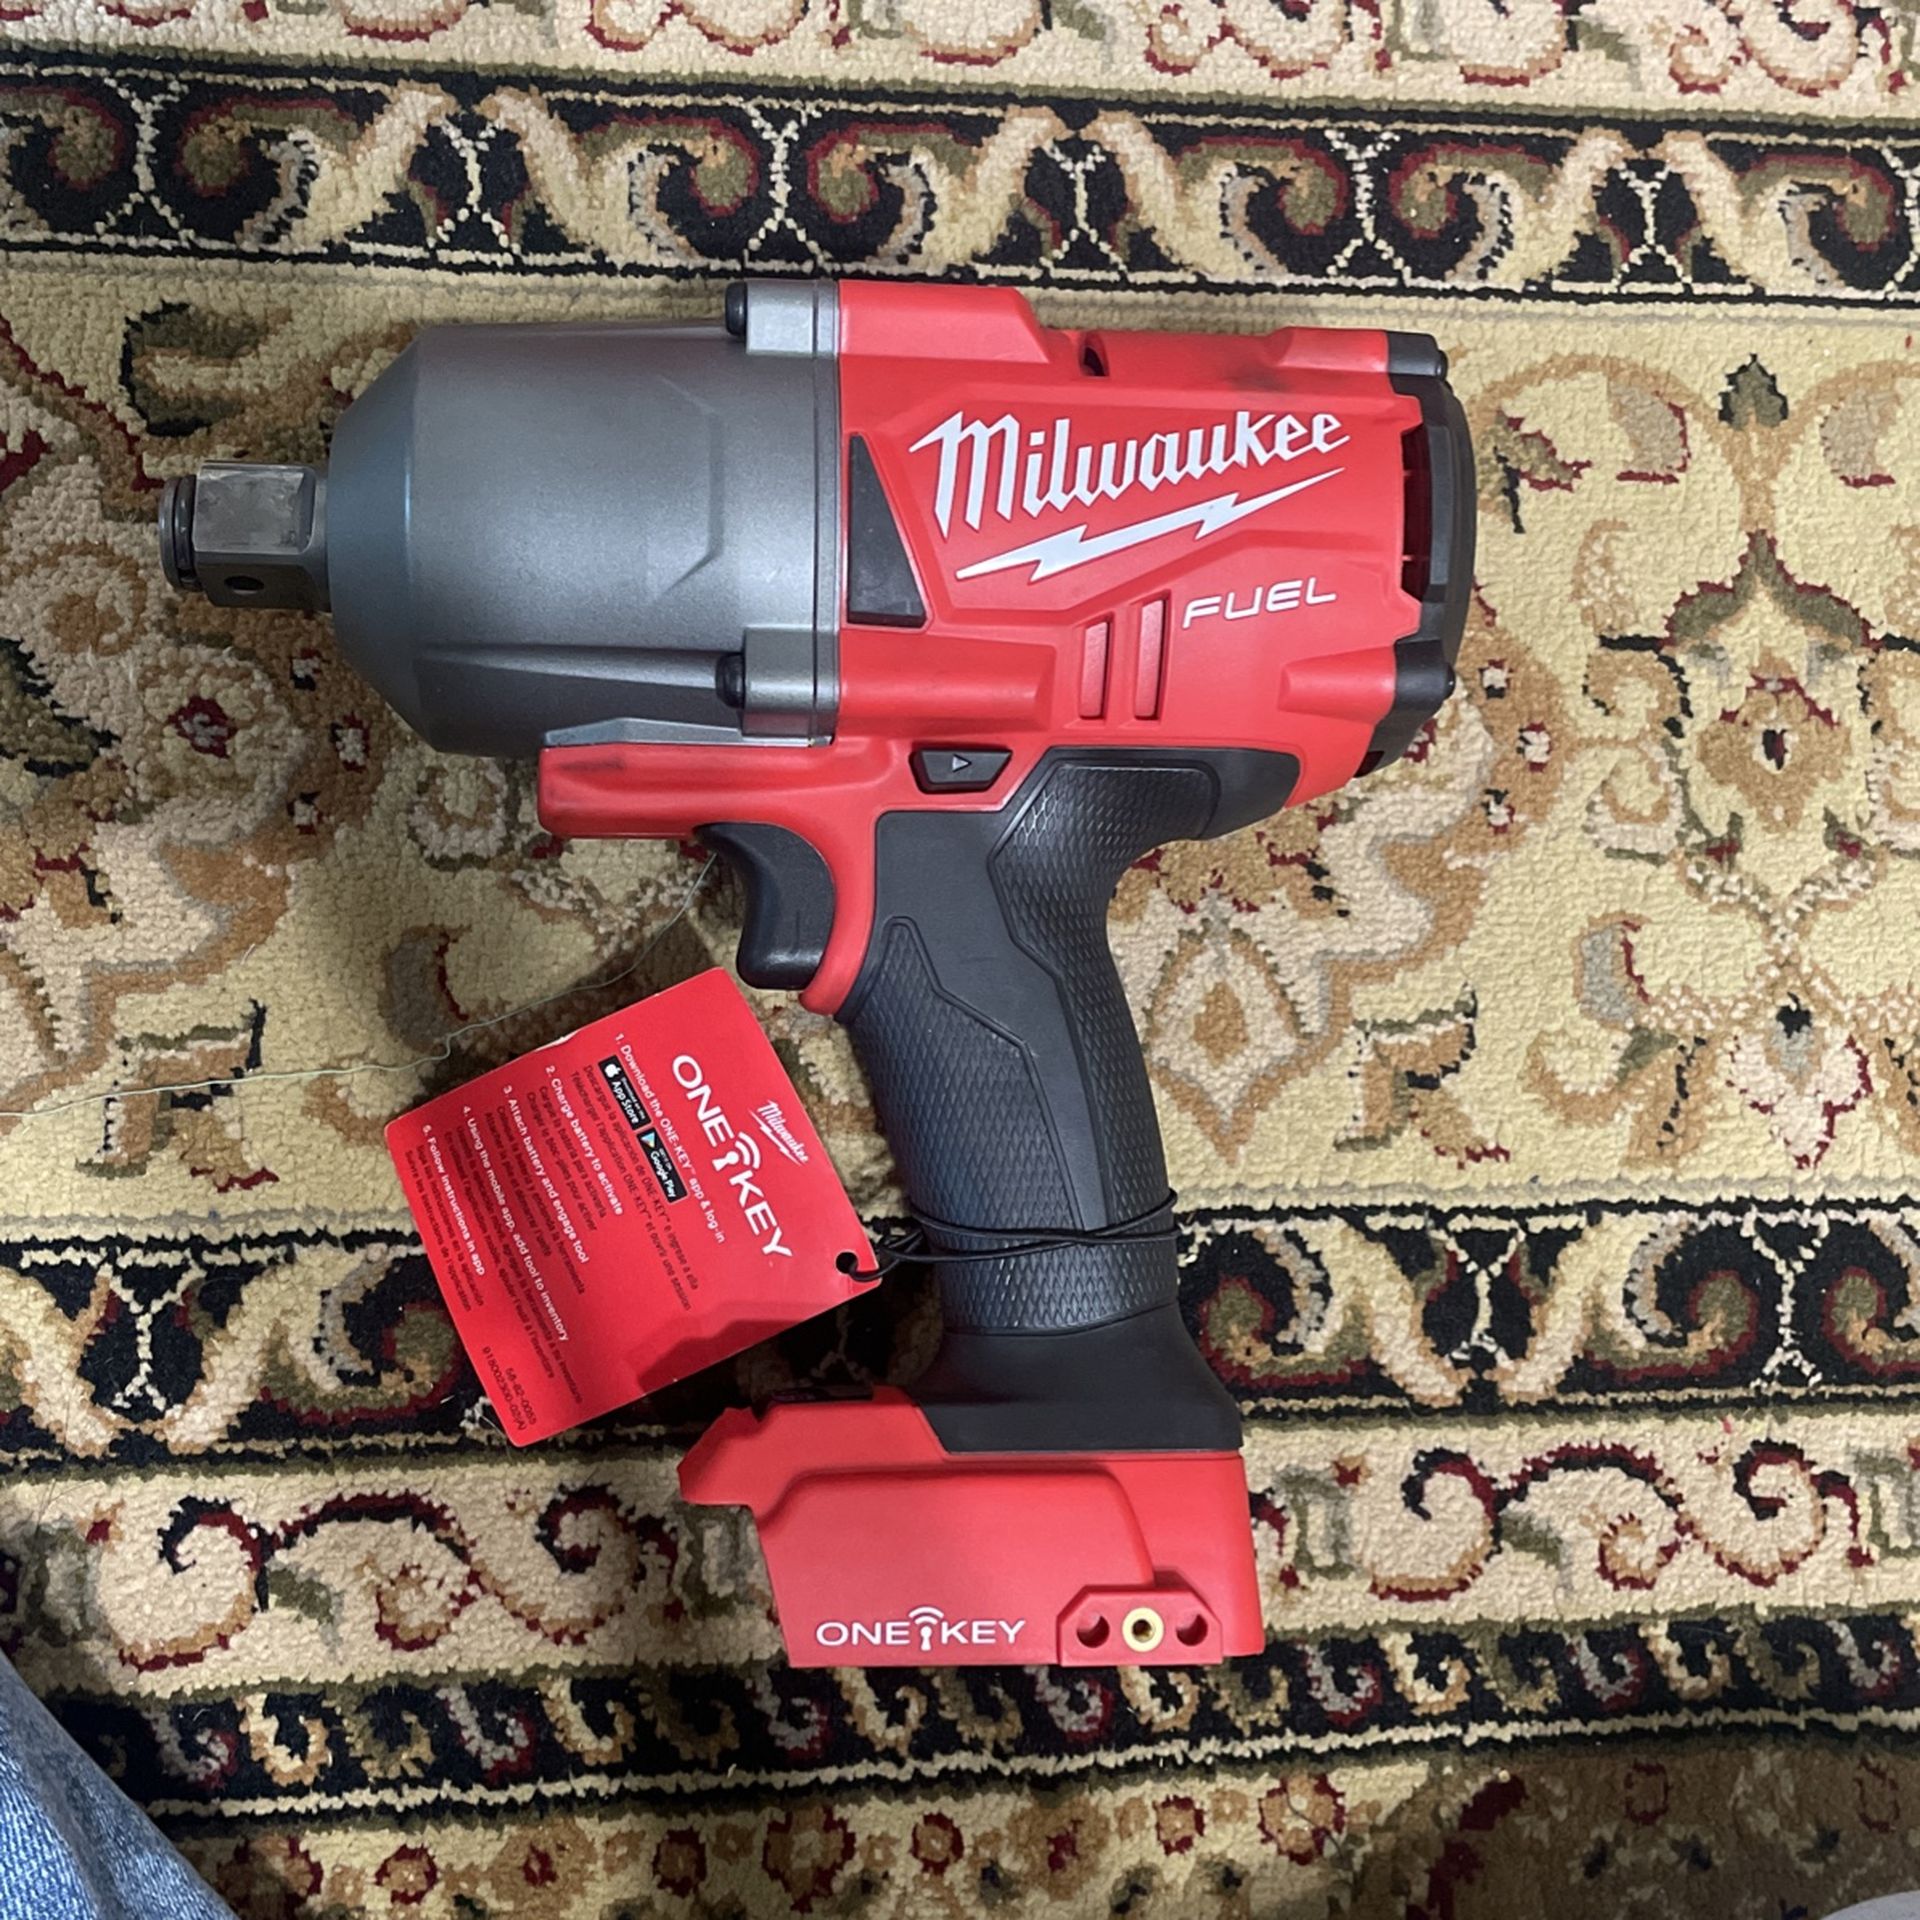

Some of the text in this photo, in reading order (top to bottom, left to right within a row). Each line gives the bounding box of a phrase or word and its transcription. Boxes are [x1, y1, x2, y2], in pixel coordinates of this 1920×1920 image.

[909, 411, 1350, 539] Milwaukee
[1182, 577, 1337, 628] FUEL
[619, 1043, 655, 1099] Download
[609, 1079, 639, 1124] App Store
[648, 1098, 665, 1118] the
[464, 1116, 485, 1151] Using
[544, 1064, 625, 1216] 2. Charge battery to activate
[757, 1099, 810, 1163] Milwaukee
[426, 1136, 447, 1174] Follow
[479, 1148, 493, 1169] the
[486, 1167, 508, 1205] mobile
[507, 1097, 529, 1136] Attach
[520, 1134, 547, 1178] battery
[541, 1175, 558, 1199] and
[550, 1198, 577, 1241] engage
[572, 1239, 590, 1263] tool
[647, 1150, 677, 1198] Google Play
[686, 1177, 704, 1201] app
[440, 1173, 472, 1240] instructions
[499, 1205, 517, 1233] app,
[699, 1198, 711, 1209] &
[512, 1231, 529, 1255] add
[702, 1208, 727, 1244] log-in
[466, 1239, 477, 1253] in
[469, 1252, 486, 1276] app
[523, 1254, 540, 1277] tool
[534, 1277, 546, 1291] to
[538, 1290, 571, 1343] inventory
